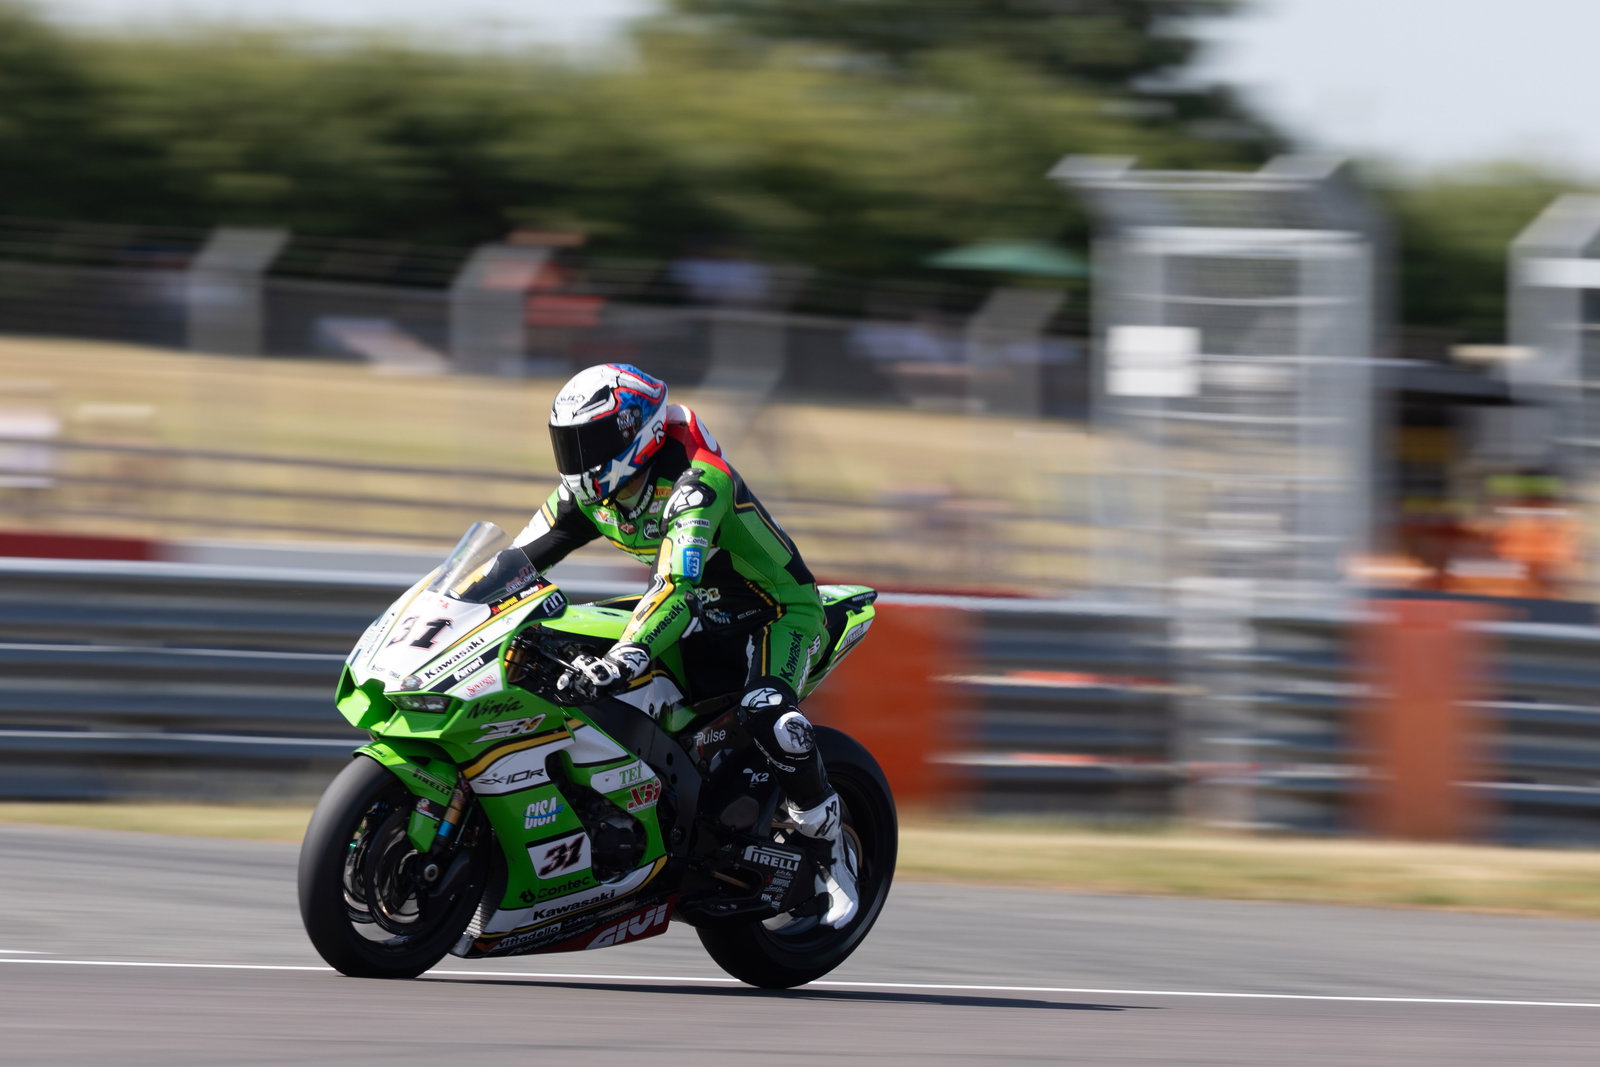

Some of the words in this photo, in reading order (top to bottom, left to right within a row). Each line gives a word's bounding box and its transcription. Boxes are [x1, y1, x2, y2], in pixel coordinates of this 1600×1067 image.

[385, 615, 453, 649] 31
[424, 636, 485, 679] Kawasaki
[468, 697, 524, 719] Ninja
[695, 729, 727, 746] Pulse
[750, 772, 770, 783] K2
[524, 797, 557, 830] CISA
[538, 833, 586, 877] 31
[744, 845, 802, 871] PIRELLI
[537, 875, 592, 898] Contec
[533, 889, 616, 921] Kawasaki
[585, 903, 668, 950] GIVI
